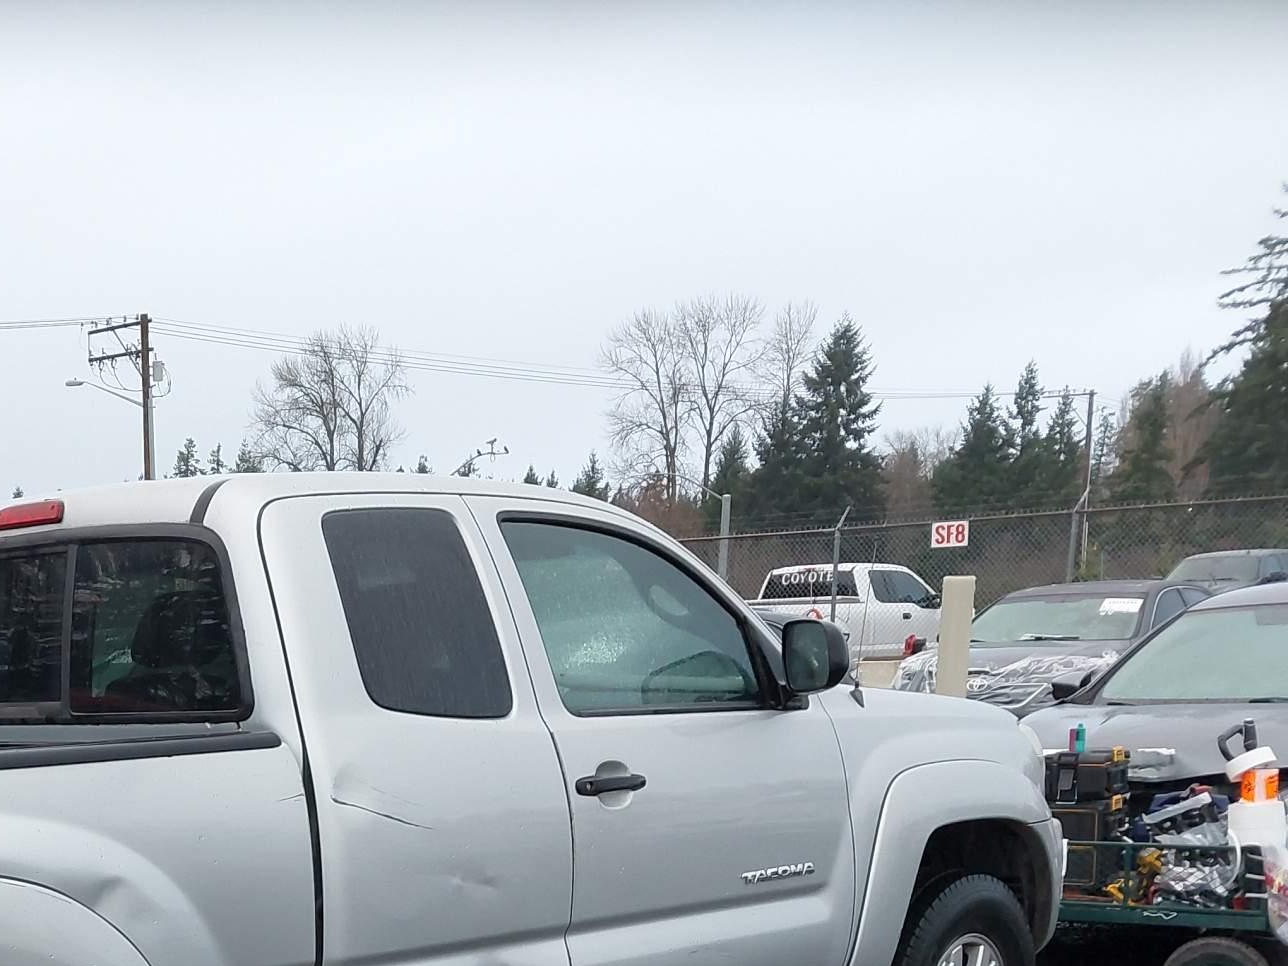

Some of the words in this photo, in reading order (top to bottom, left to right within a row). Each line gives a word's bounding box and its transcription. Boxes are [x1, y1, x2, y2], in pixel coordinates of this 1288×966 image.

[935, 524, 965, 545] SF8
[781, 571, 834, 585] COYOTE
[741, 862, 815, 884] TACOMA
